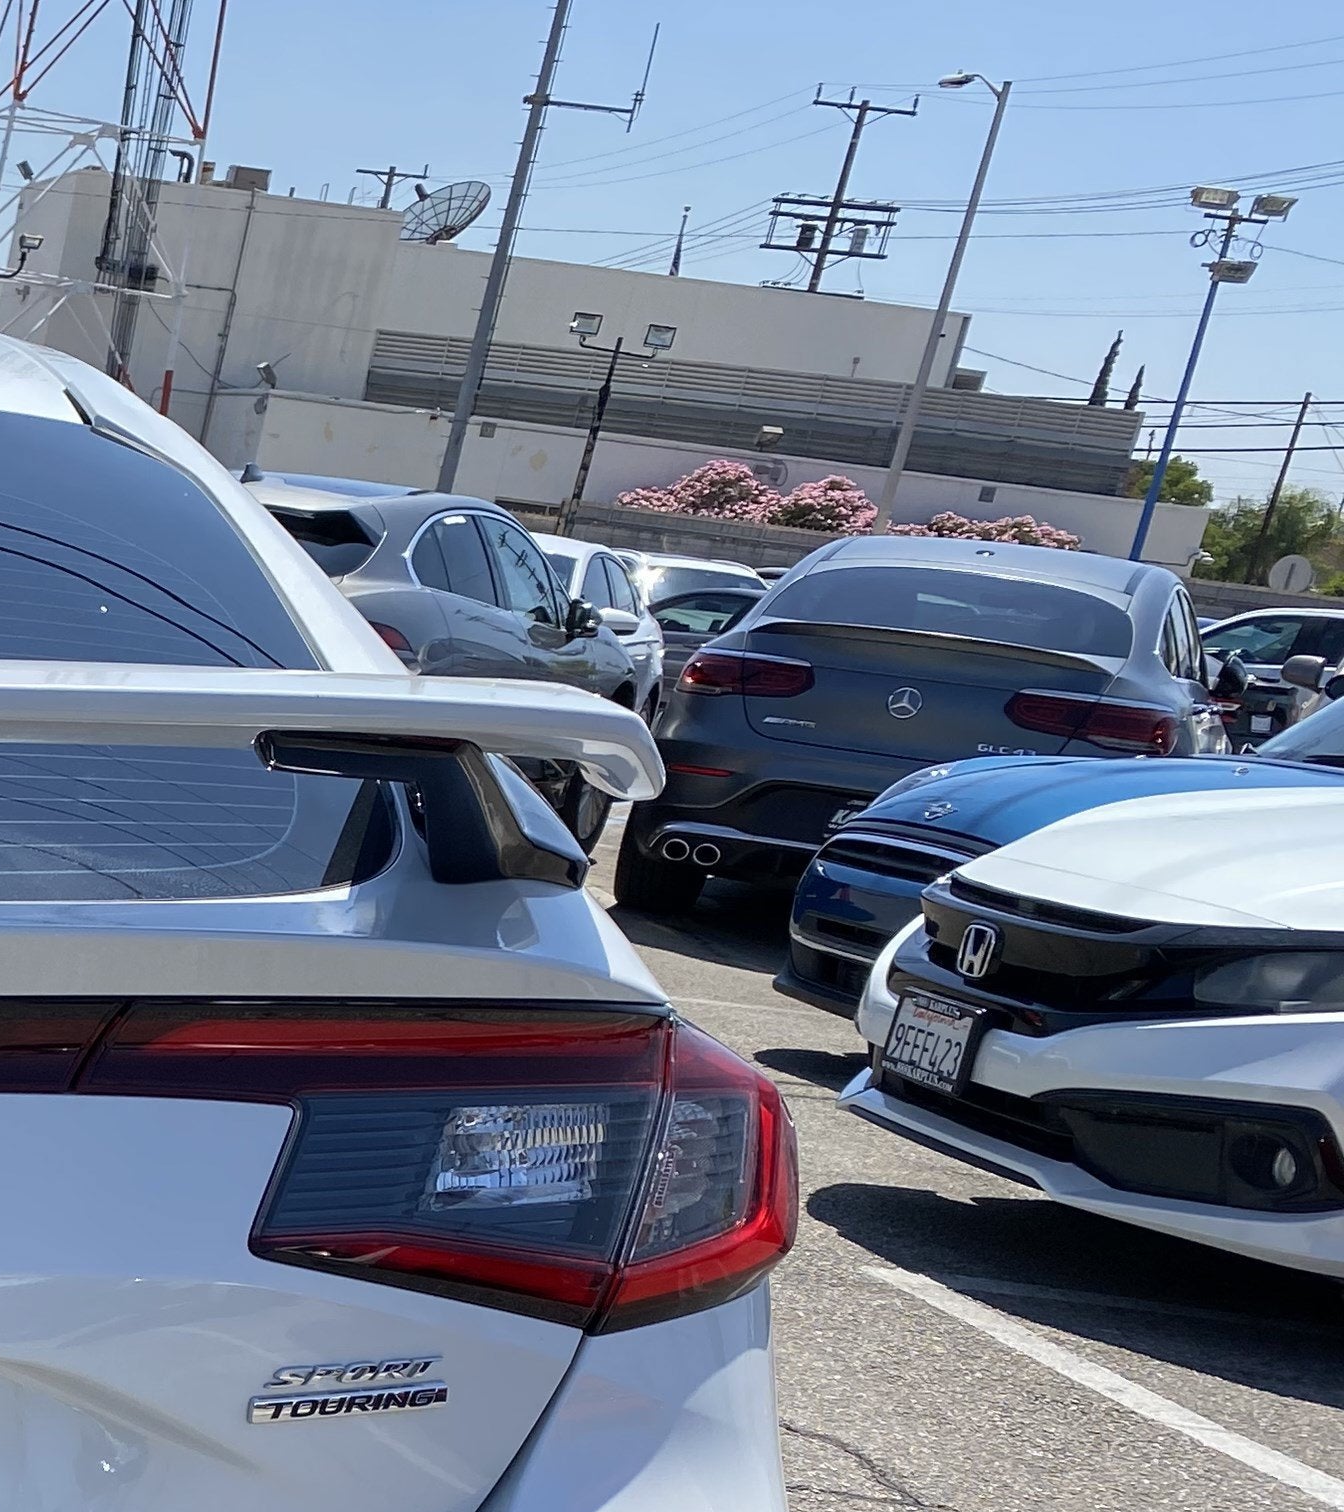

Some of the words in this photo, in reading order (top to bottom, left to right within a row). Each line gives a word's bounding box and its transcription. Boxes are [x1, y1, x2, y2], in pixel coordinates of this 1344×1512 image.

[977, 743, 1010, 754] GLC
[263, 1355, 445, 1389] SPORT
[261, 1387, 438, 1420] TOURING
